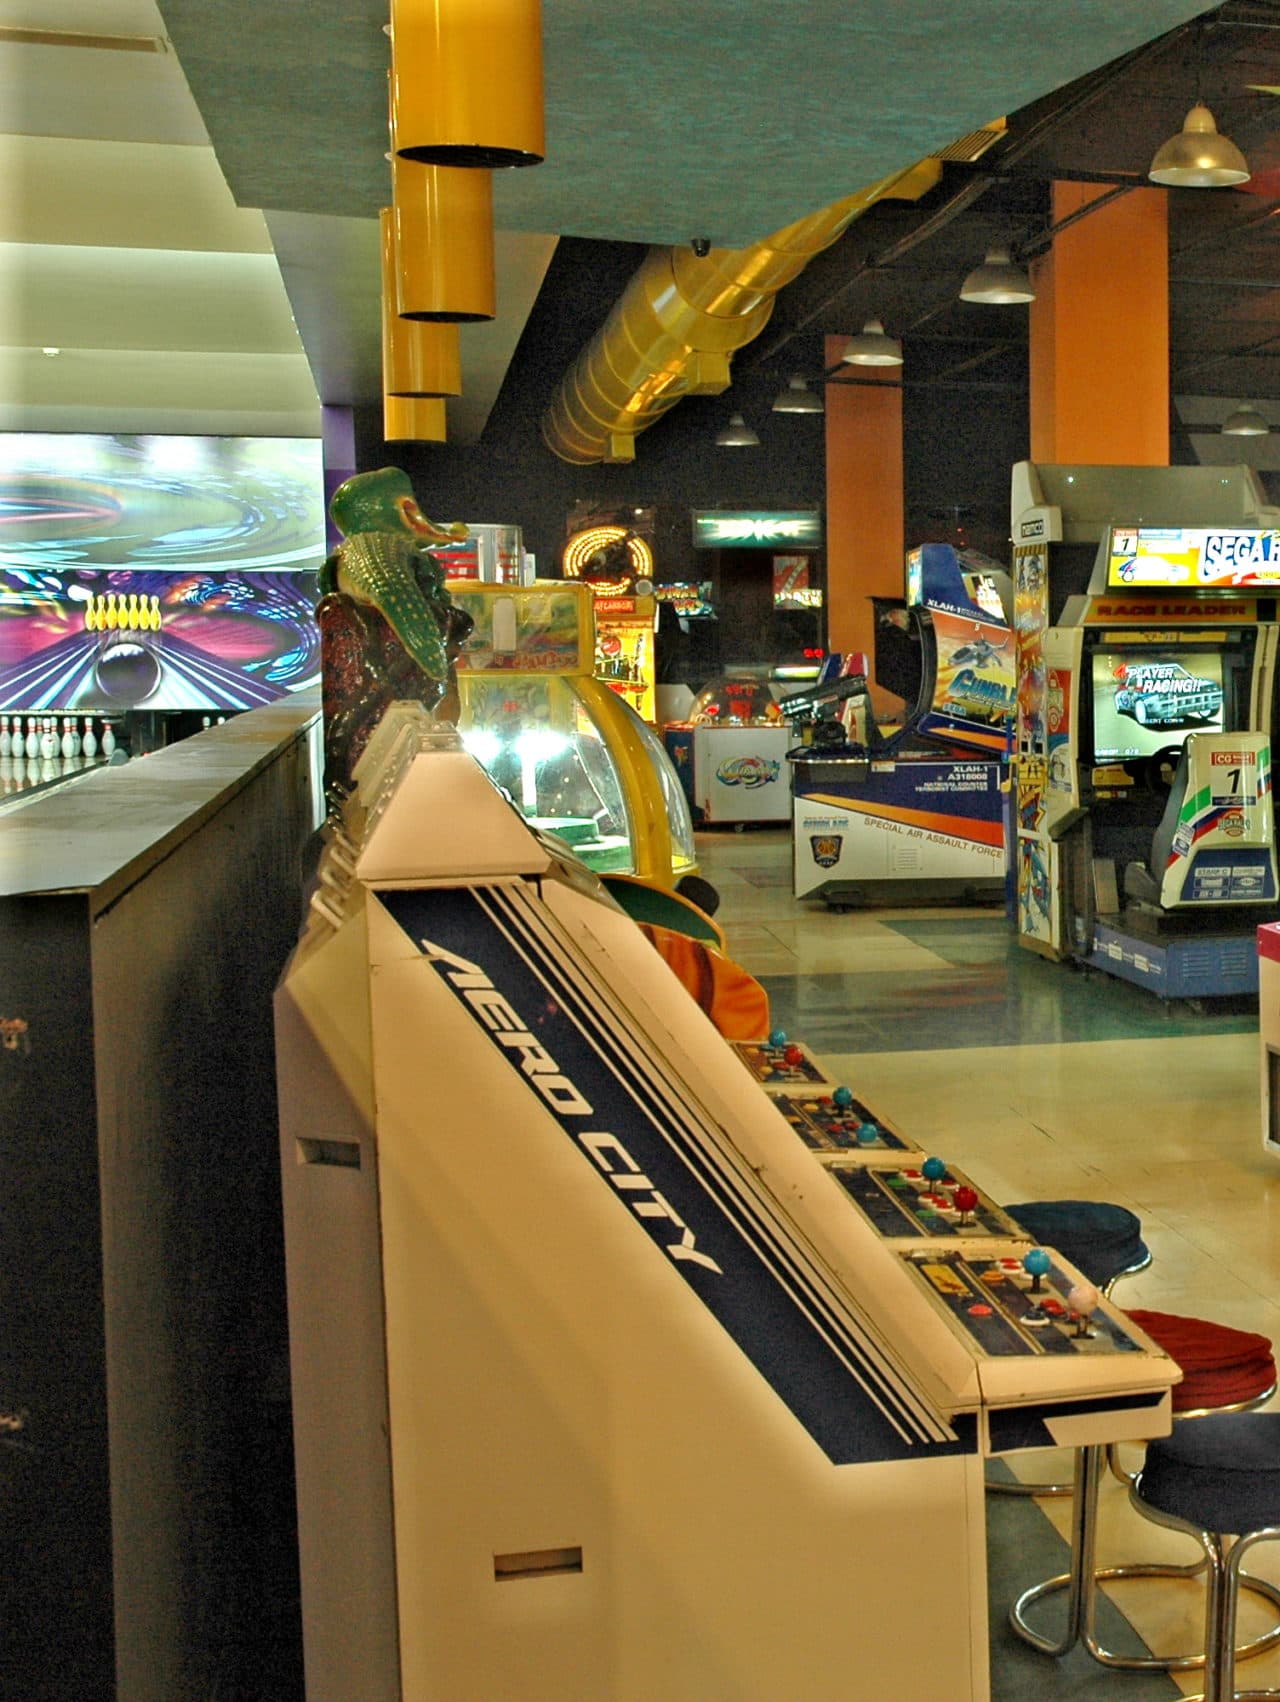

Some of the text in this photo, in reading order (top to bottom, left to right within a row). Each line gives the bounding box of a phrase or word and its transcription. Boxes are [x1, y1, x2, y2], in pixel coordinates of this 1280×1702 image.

[1203, 535, 1266, 578] SEGA
[1097, 604, 1246, 617] RACE LEADER
[1127, 667, 1174, 679] PLAYER
[1142, 679, 1201, 693] RACING!!
[953, 765, 988, 773] XLAH-1
[1227, 768, 1241, 794] 1
[863, 816, 903, 835] SPECIAL
[906, 828, 923, 839] AIR
[926, 833, 970, 850] ASSAULT
[971, 844, 1003, 859] FORCE
[421, 938, 727, 1276] AERO CITY
